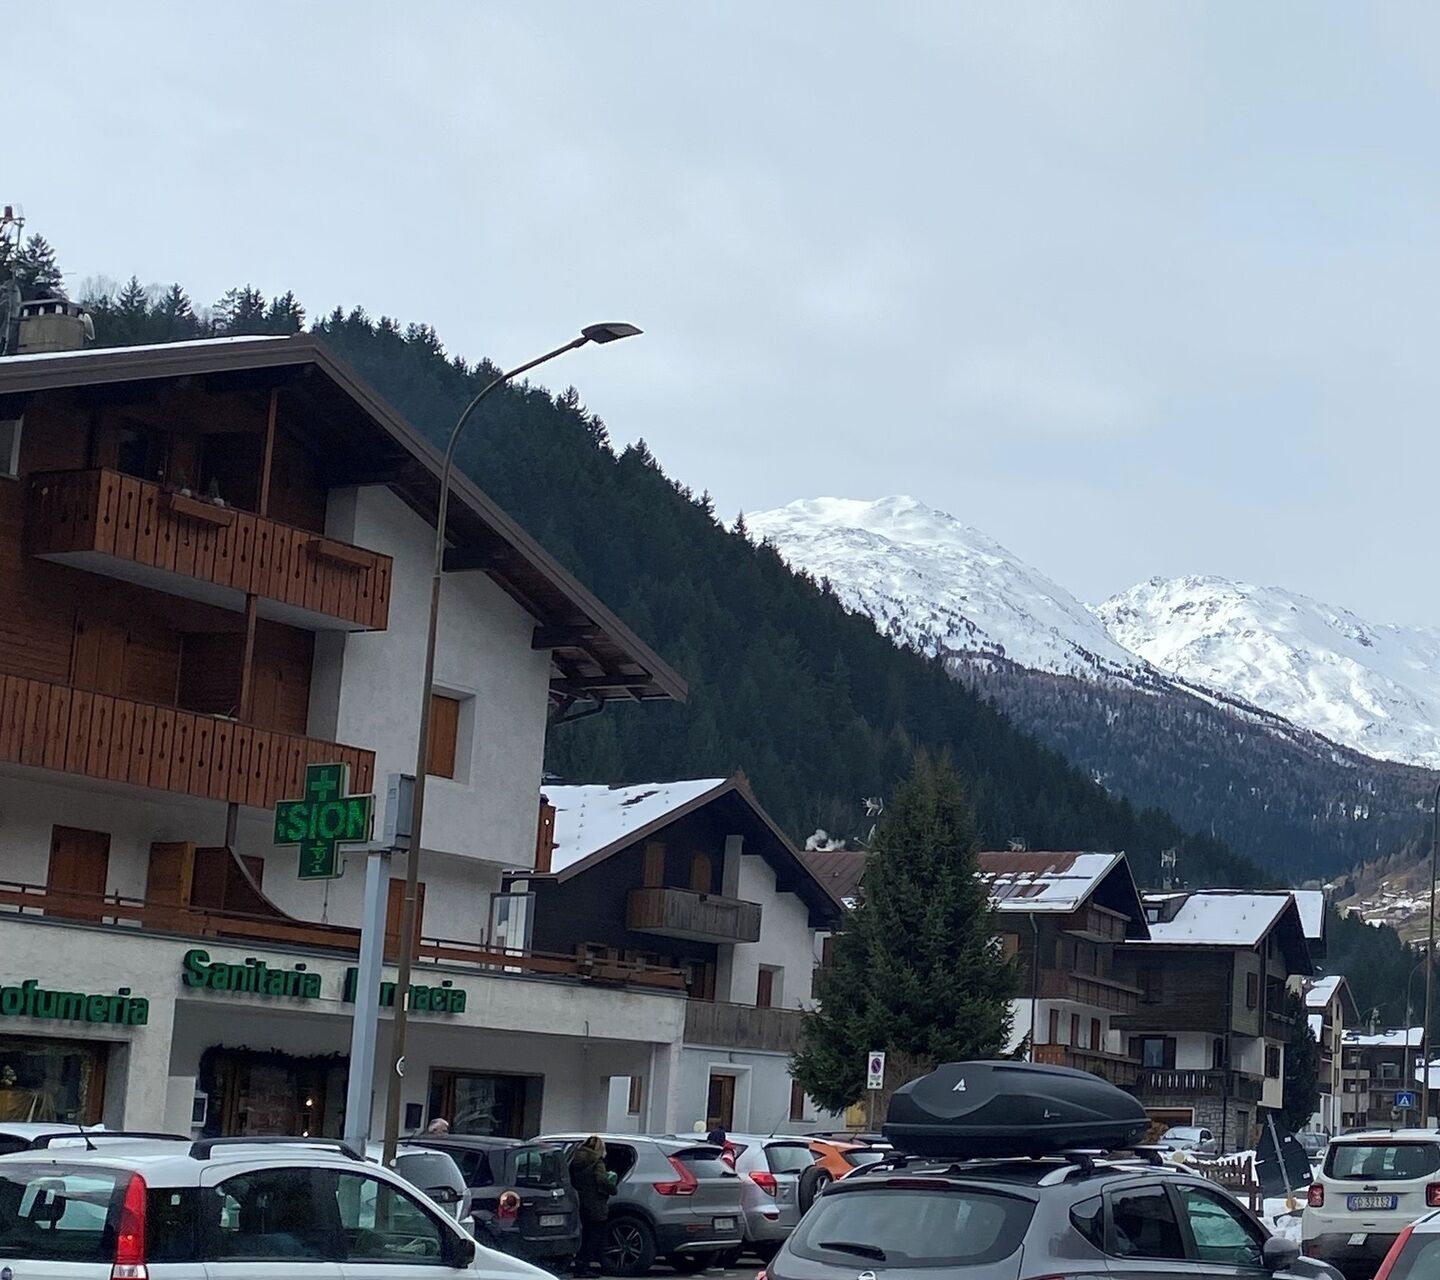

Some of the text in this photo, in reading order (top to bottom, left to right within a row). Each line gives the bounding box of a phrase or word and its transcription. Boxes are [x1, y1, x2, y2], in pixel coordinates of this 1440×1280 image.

[0, 979, 149, 1025] ofumeria
[182, 949, 467, 1013] Sanitaria racia
